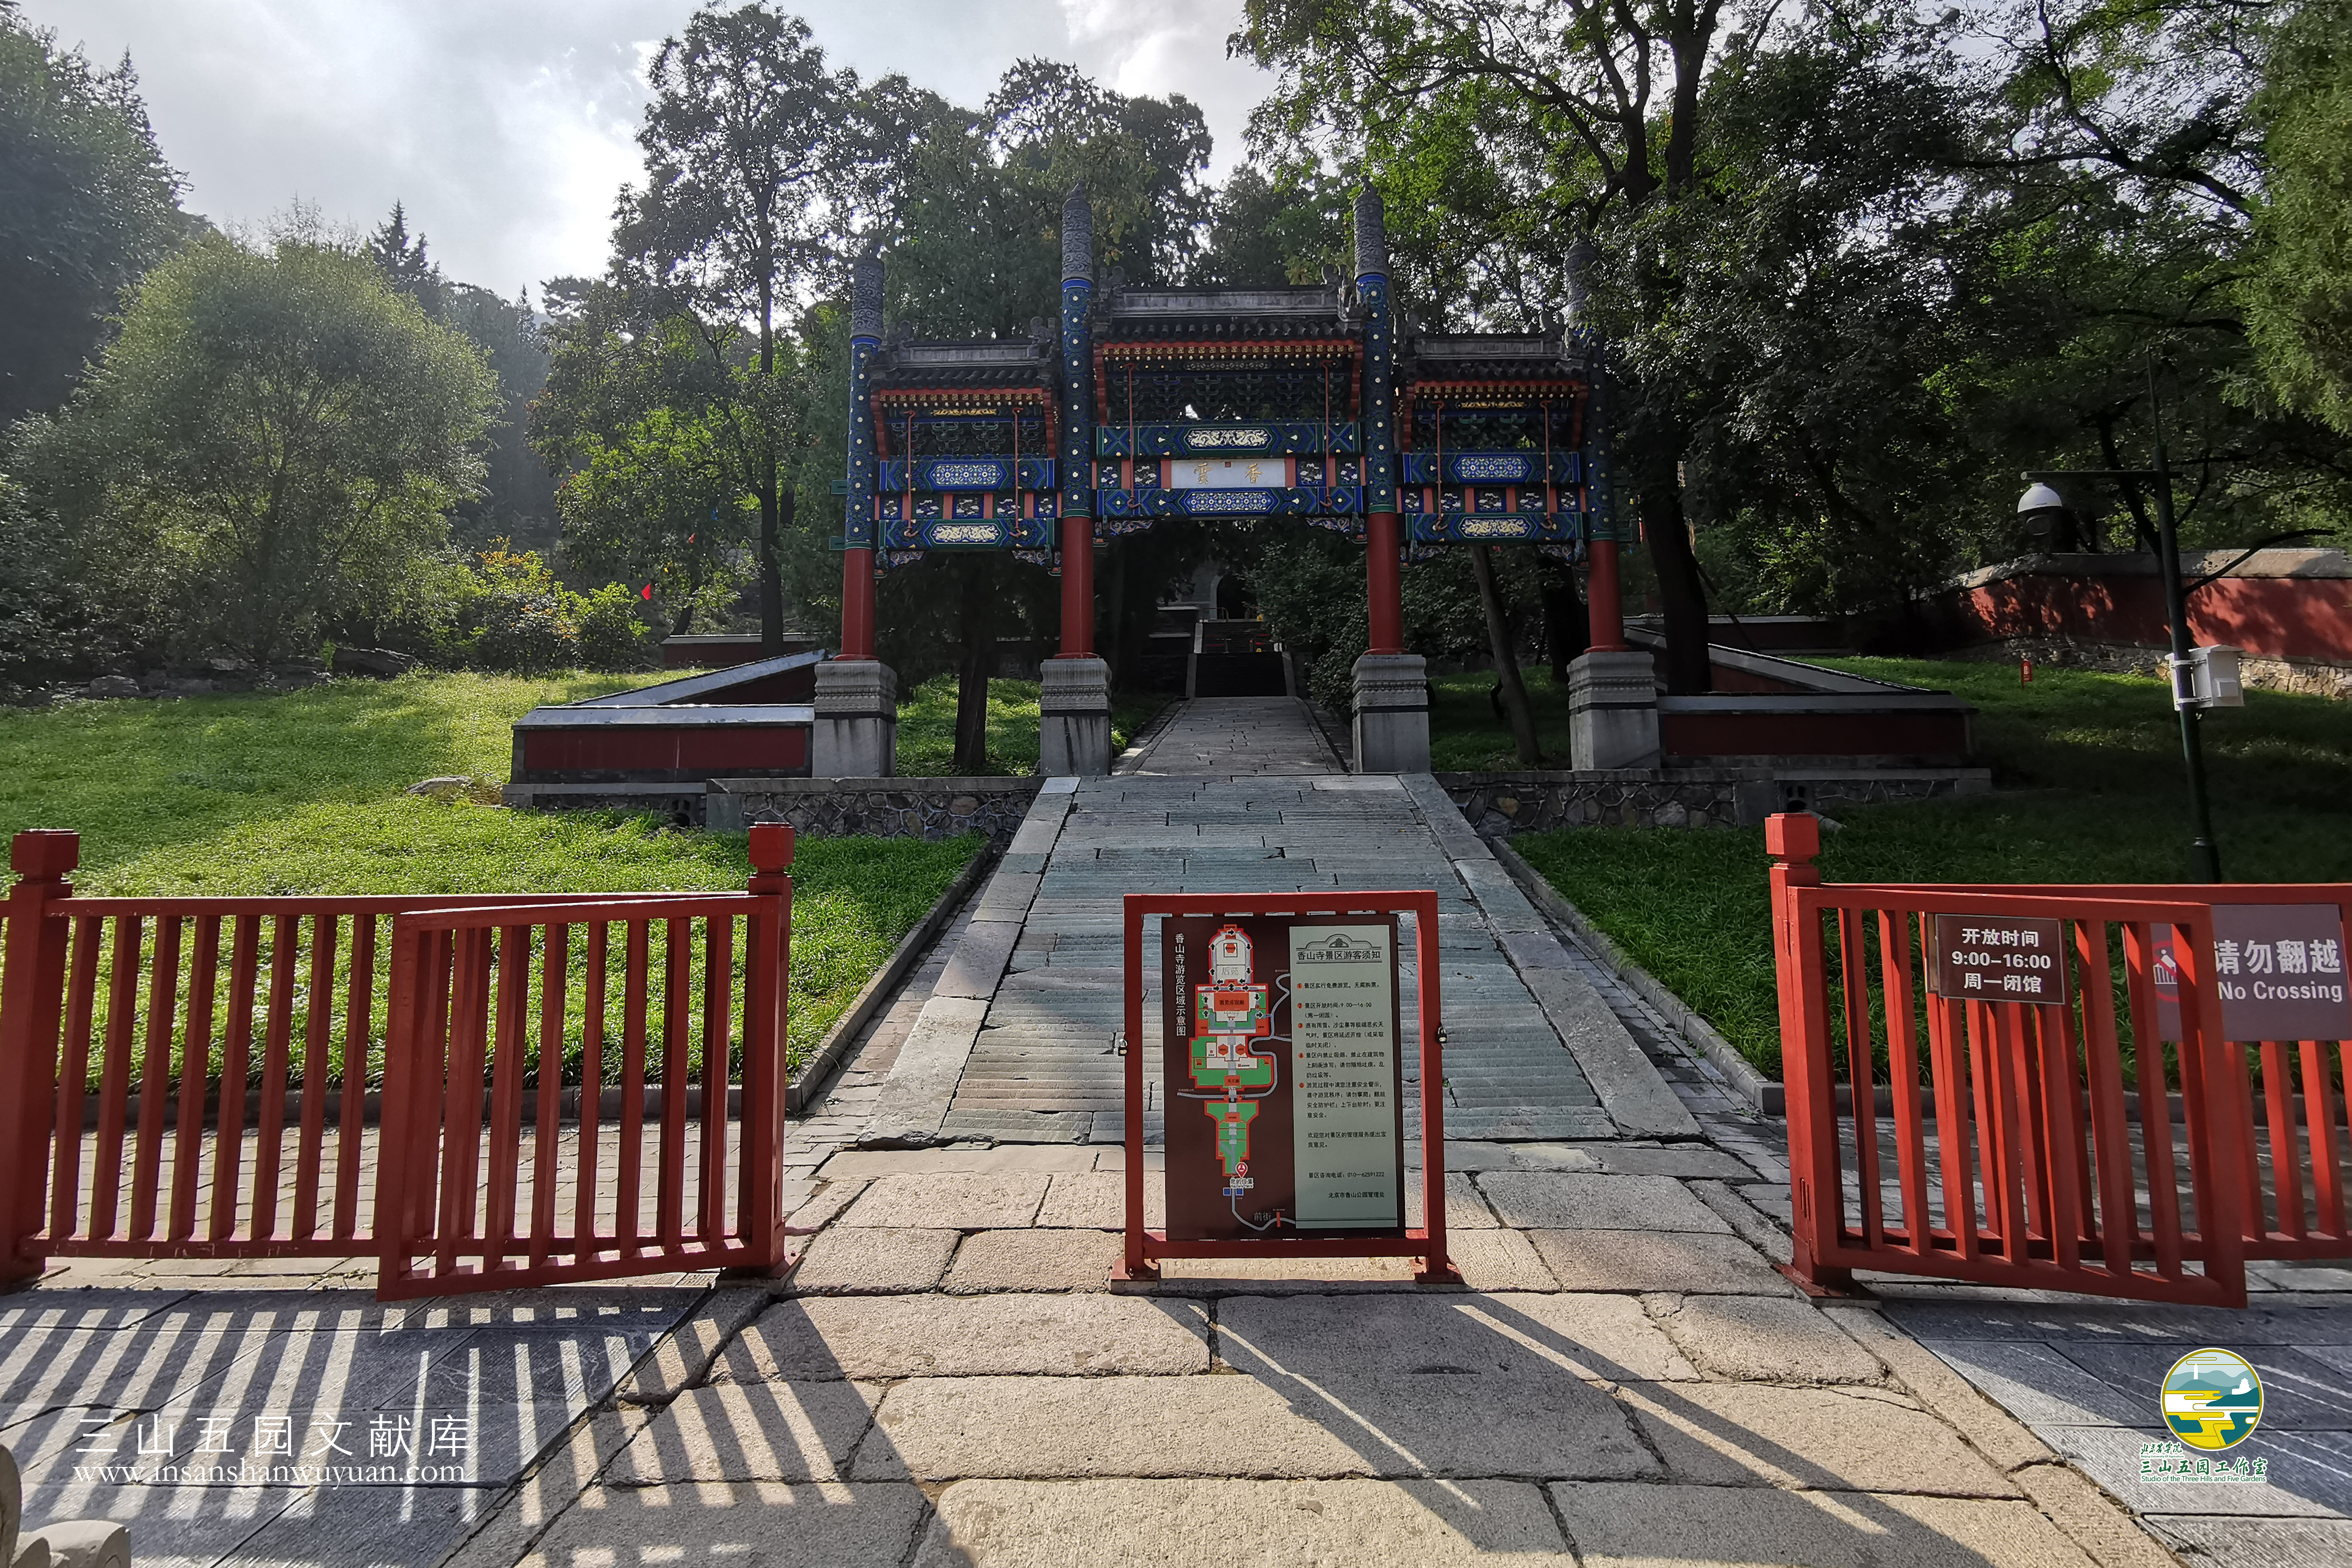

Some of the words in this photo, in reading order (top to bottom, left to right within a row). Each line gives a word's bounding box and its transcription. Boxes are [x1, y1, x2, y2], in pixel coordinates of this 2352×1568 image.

[1962, 928, 2039, 947] 开放时间
[1297, 951, 1380, 960] 香山寺景区游客须知
[2213, 939, 2341, 975] 请勿翻越
[1175, 933, 1186, 1036] 香山寺游览区域示意图
[1963, 972, 2041, 993] 周一闭馆
[2218, 981, 2246, 1000] No
[2253, 980, 2343, 1003] Crossing
[1253, 1212, 1271, 1221] 前街
